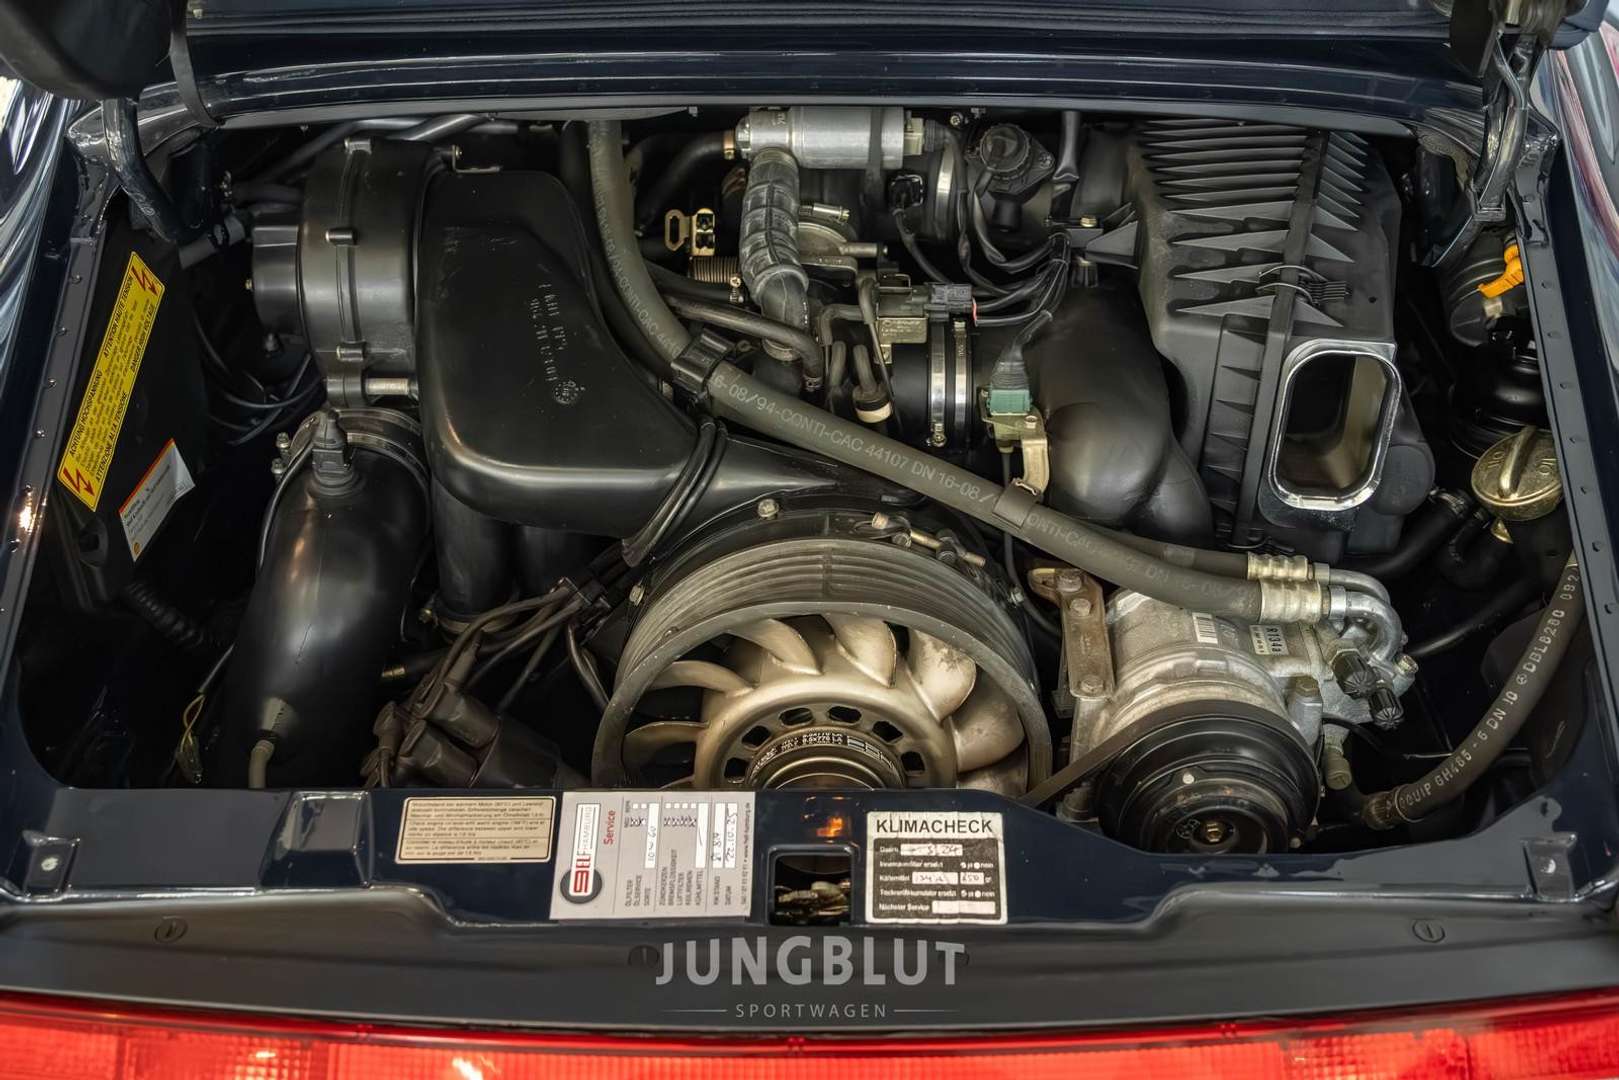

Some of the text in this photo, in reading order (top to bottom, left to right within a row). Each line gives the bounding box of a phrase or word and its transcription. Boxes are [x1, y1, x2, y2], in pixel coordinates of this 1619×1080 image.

[69, 424, 85, 456] ACHTUNG
[911, 460, 937, 481] DN
[1486, 708, 1506, 729] DN
[1502, 691, 1518, 705] 10
[603, 809, 616, 846] Service
[876, 819, 993, 834] KLIMACHECK
